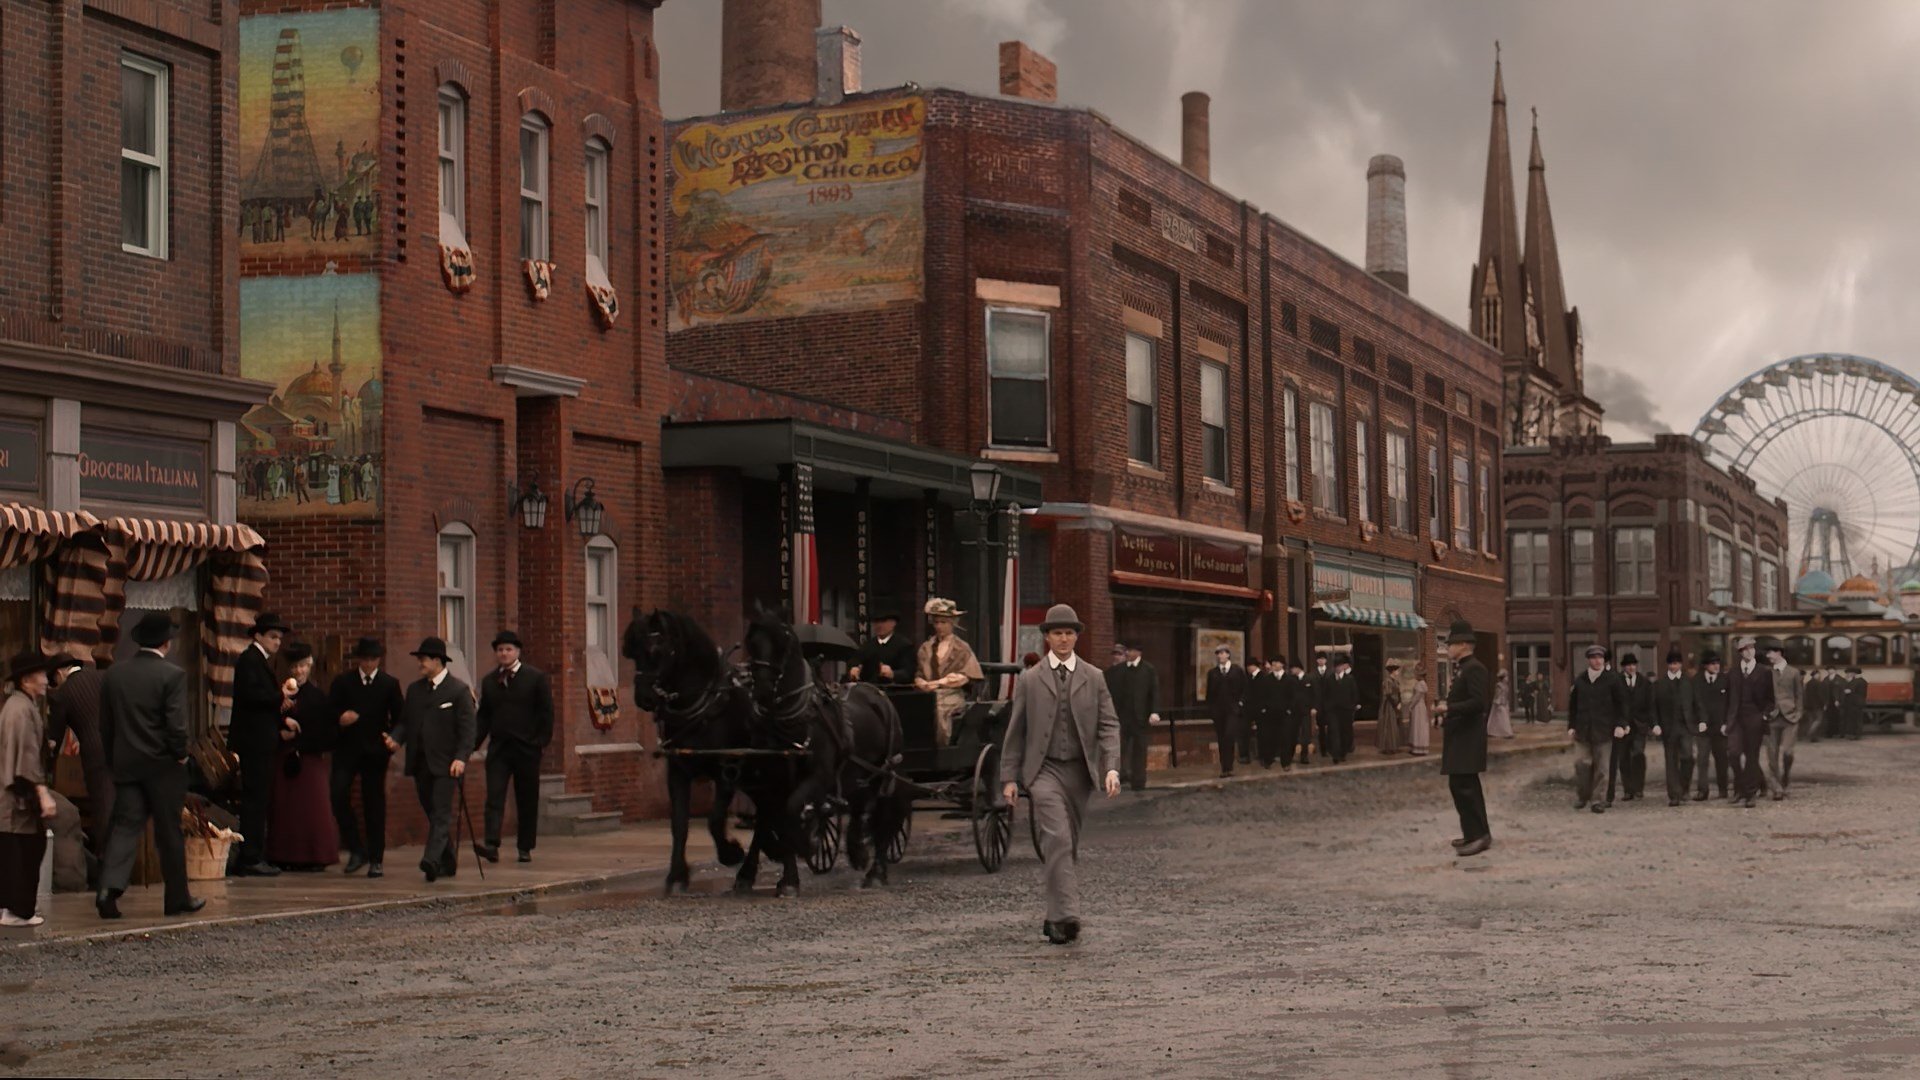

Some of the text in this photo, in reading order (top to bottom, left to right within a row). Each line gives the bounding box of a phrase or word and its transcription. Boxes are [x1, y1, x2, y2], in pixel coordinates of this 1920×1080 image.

[803, 156, 914, 180] CHICAGO
[807, 185, 853, 204] 1893
[858, 511, 866, 574] SHOES
[1193, 553, 1244, 573] Restaurant
[858, 579, 866, 615] FOR
